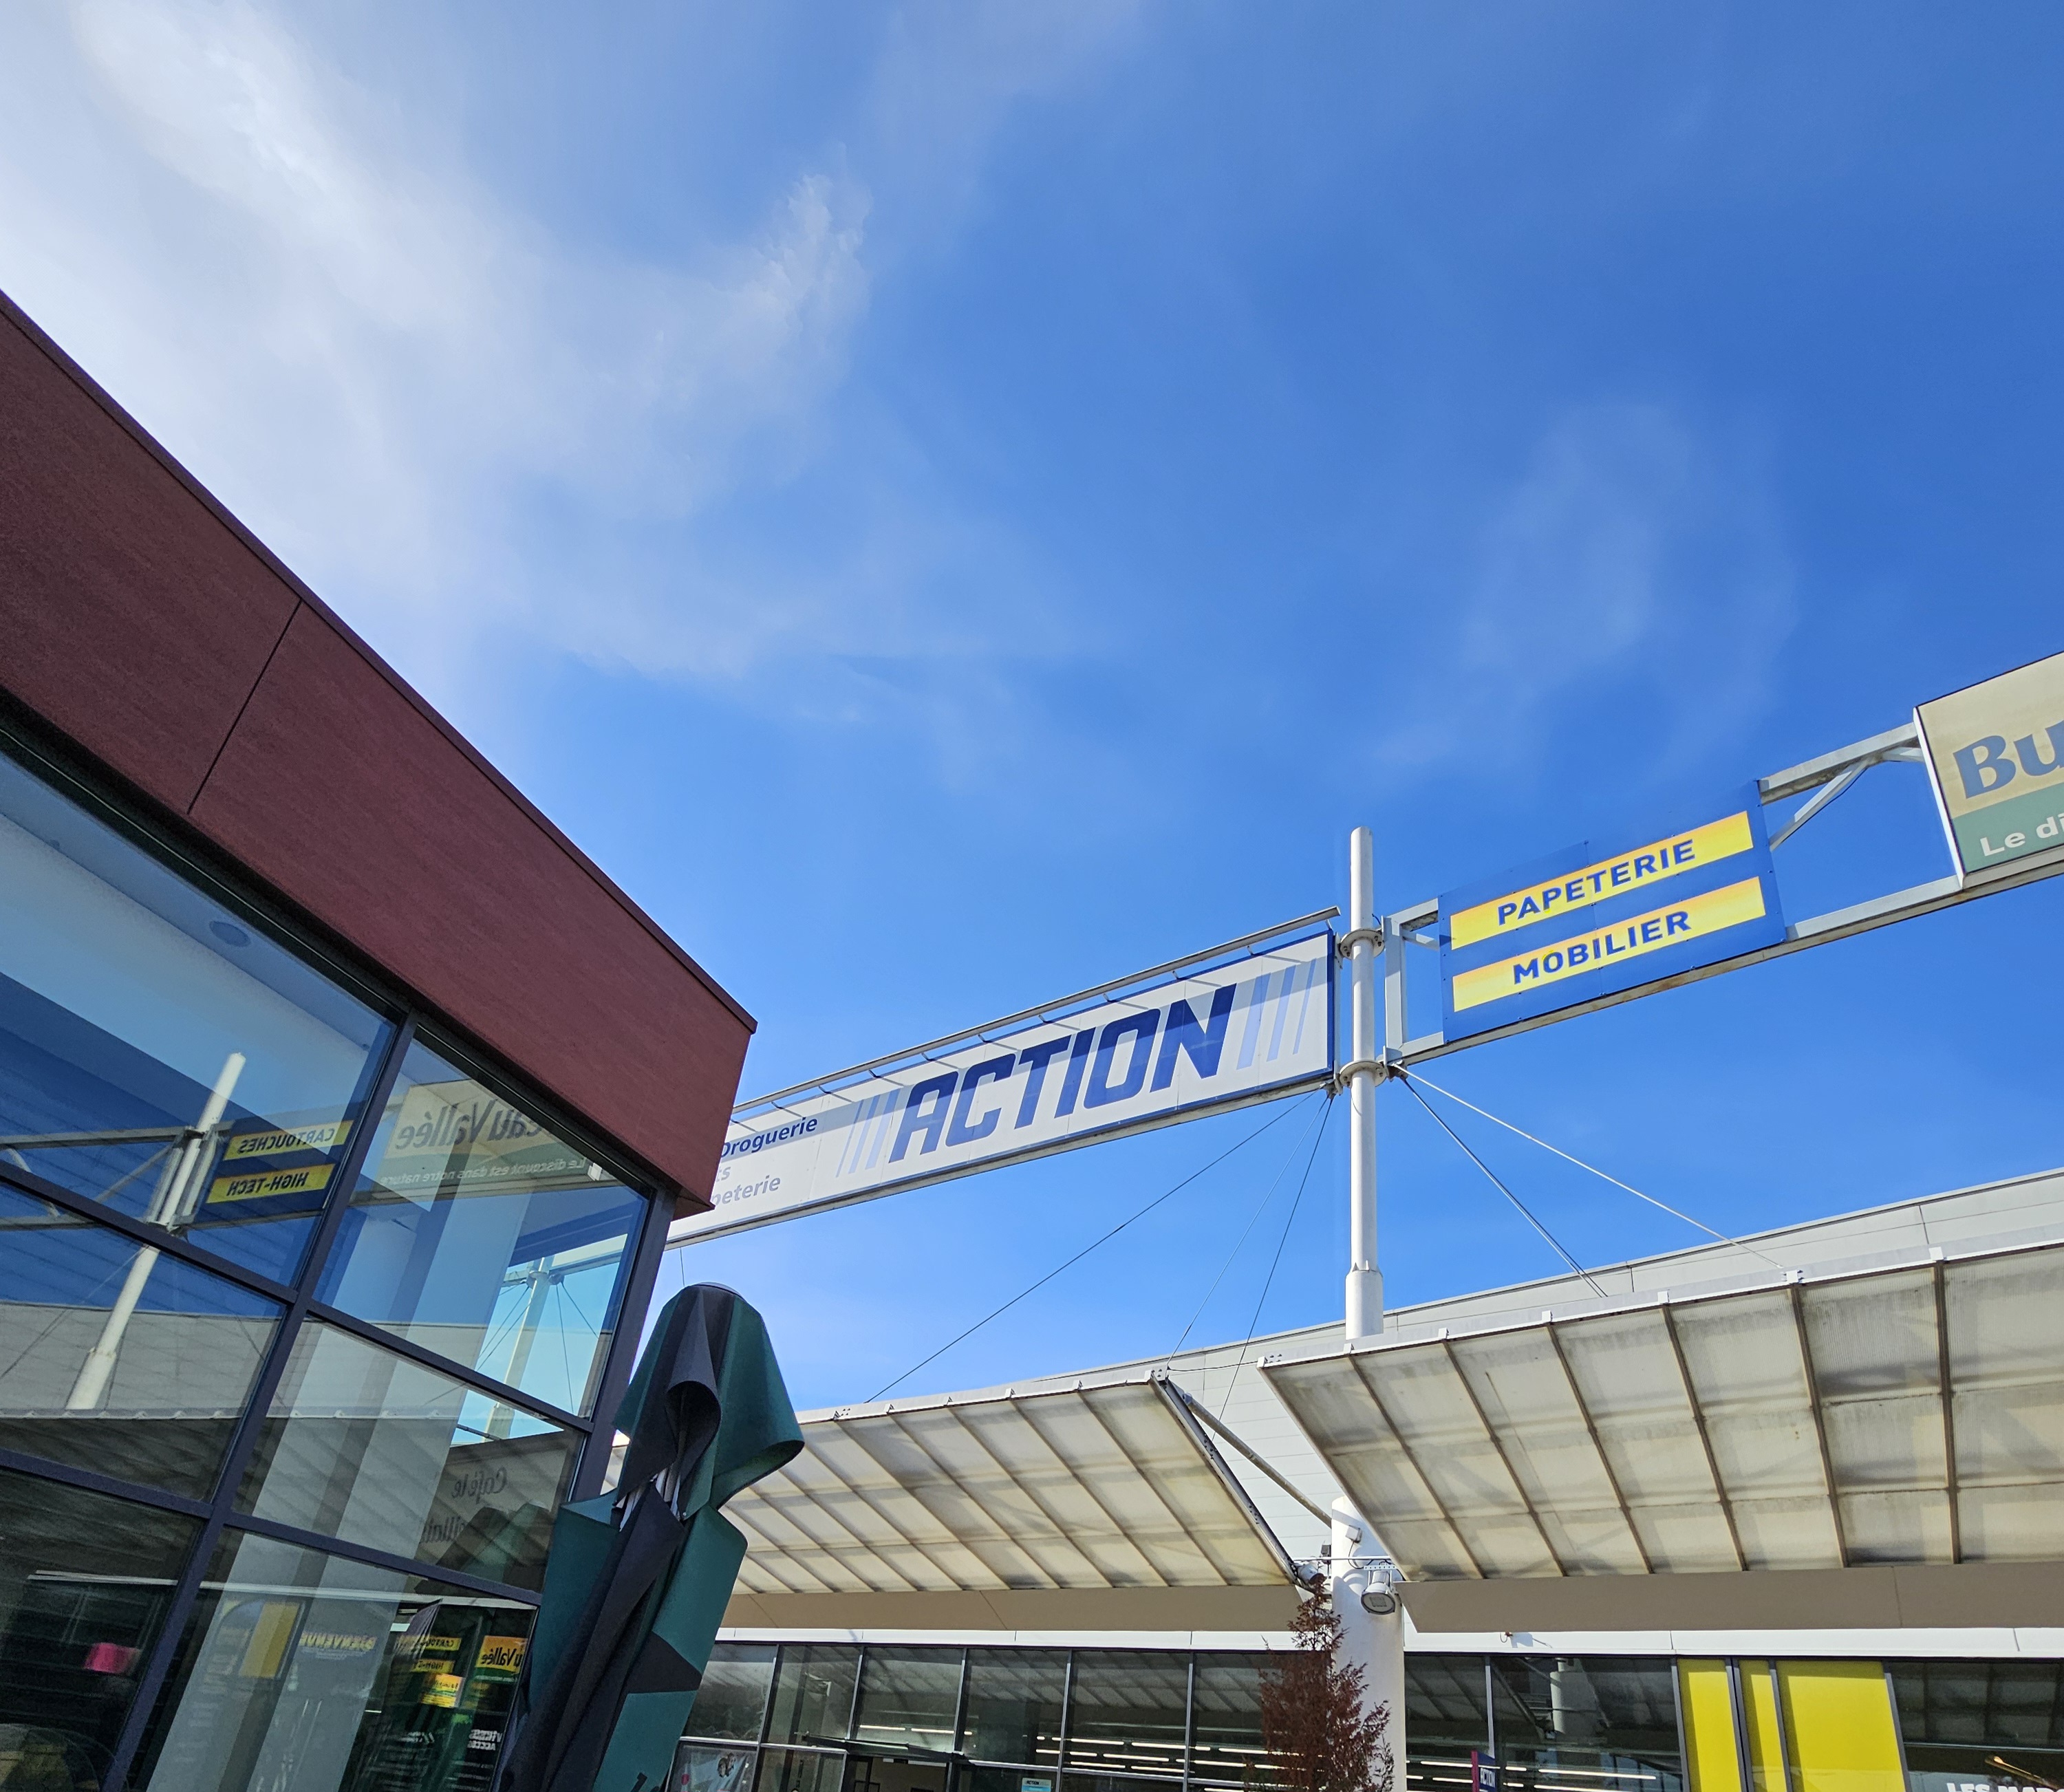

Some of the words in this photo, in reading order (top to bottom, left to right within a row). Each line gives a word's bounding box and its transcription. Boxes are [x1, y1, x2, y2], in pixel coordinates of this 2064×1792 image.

[1953, 720, 2064, 799] Bu
[1498, 839, 1695, 926] PAPETERIE
[1980, 832, 2025, 856] Le
[1513, 911, 1692, 985] MOBILIER
[888, 982, 1237, 1164] ACTION
